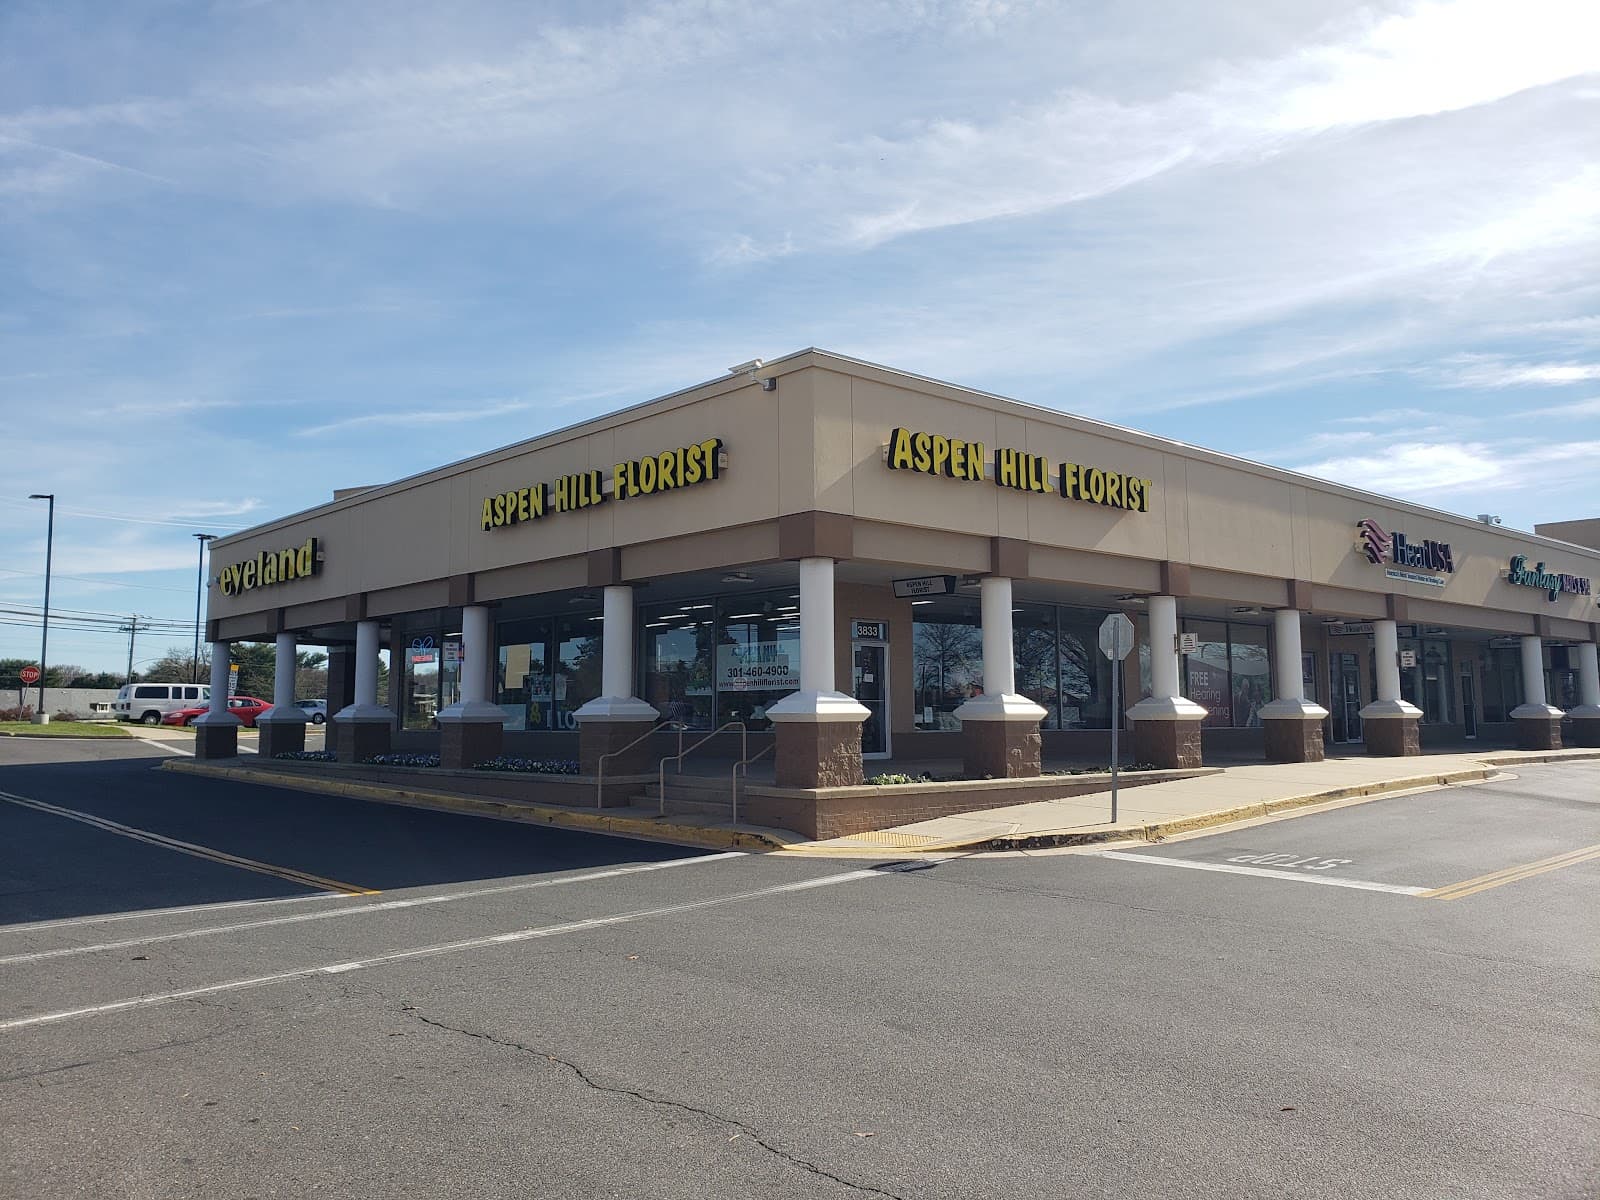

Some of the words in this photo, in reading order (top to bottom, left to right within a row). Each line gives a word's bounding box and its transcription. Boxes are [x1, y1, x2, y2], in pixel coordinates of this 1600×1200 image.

[889, 426, 984, 481] ASPEN
[995, 447, 1054, 493] HILL
[1060, 462, 1152, 512] FLORIST
[481, 483, 546, 531] ASPEN
[554, 470, 602, 513] HILL
[613, 438, 721, 500] FLORIST
[219, 536, 316, 596] eyeland
[1391, 531, 1454, 573] HearUSA
[1509, 553, 1562, 602] Fantasy
[857, 626, 878, 636] 3833
[728, 666, 789, 677] 301-460-4900
[1189, 672, 1209, 686] FREE
[1190, 688, 1221, 703] Hearing
[1226, 852, 1353, 870] STOP
